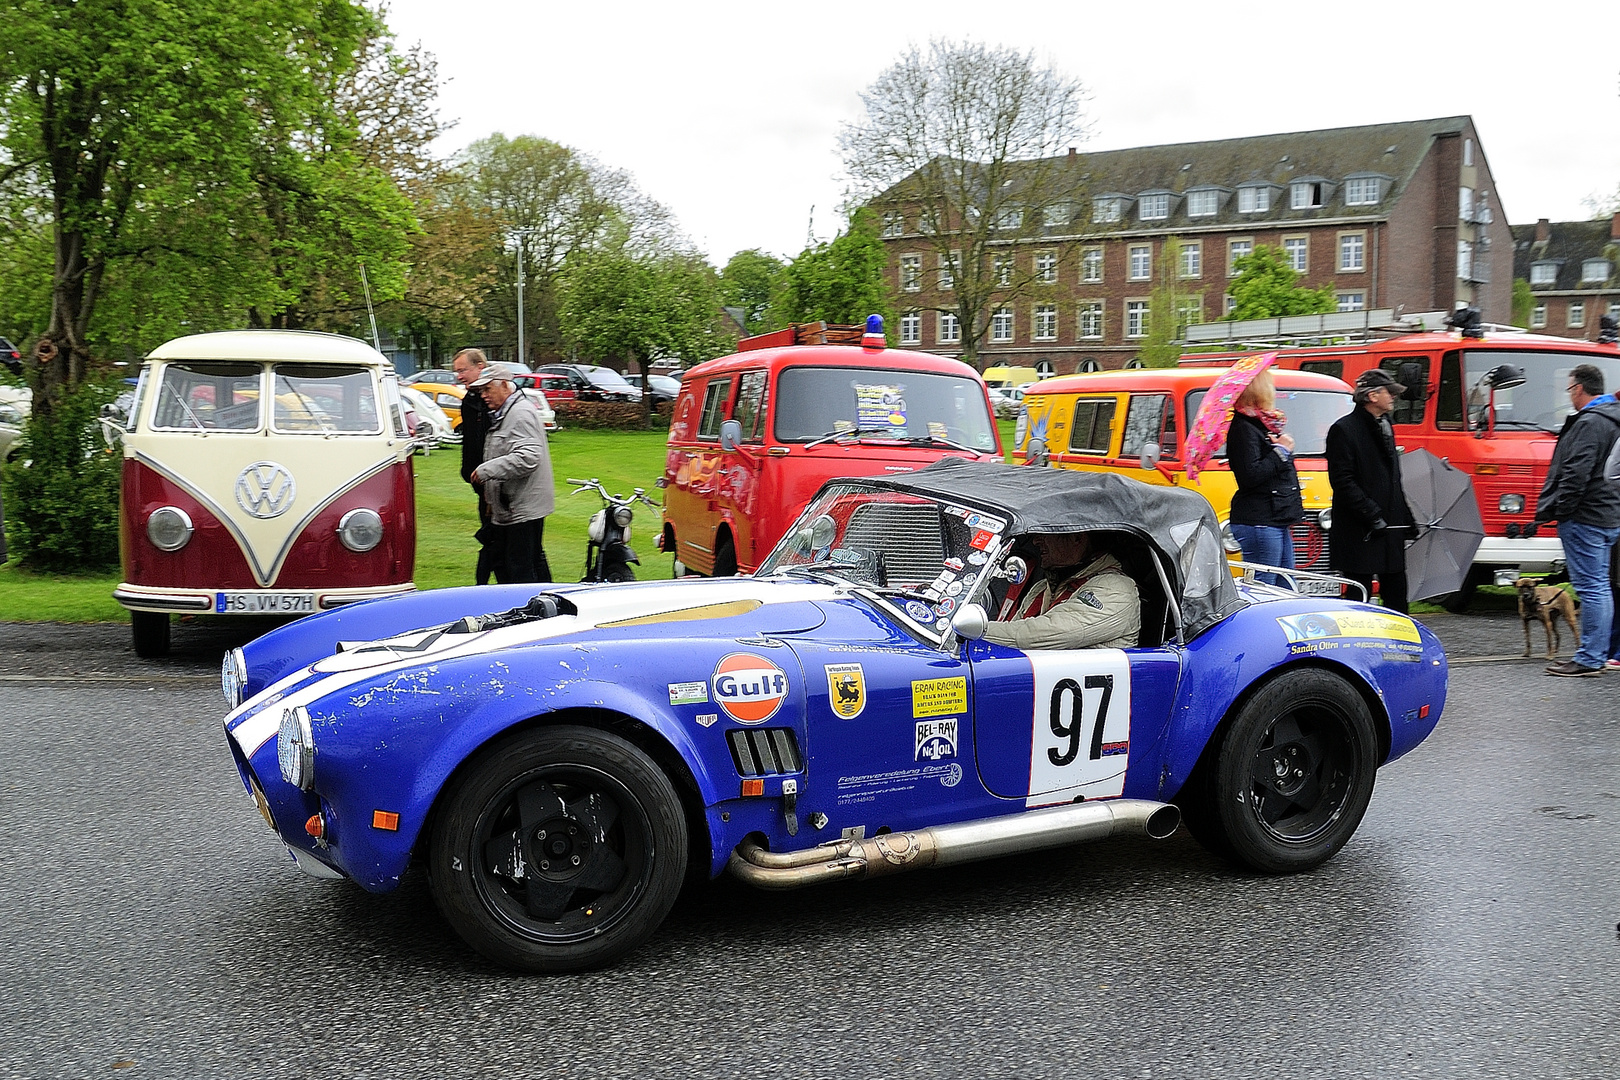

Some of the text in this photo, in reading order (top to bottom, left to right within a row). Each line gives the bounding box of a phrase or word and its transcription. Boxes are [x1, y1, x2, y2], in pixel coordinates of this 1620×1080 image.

[236, 462, 296, 517] VW
[226, 595, 246, 610] HS
[281, 595, 313, 610] 57H
[1291, 643, 1318, 655] Sandra
[716, 675, 783, 697] Gulf
[936, 680, 964, 691] RACING
[697, 715, 716, 726] HEUER
[1047, 675, 1113, 766] 97
[917, 721, 957, 744] BEL-RAY
[838, 768, 921, 783] Felgenveredelung
[923, 764, 951, 772] Ebert
